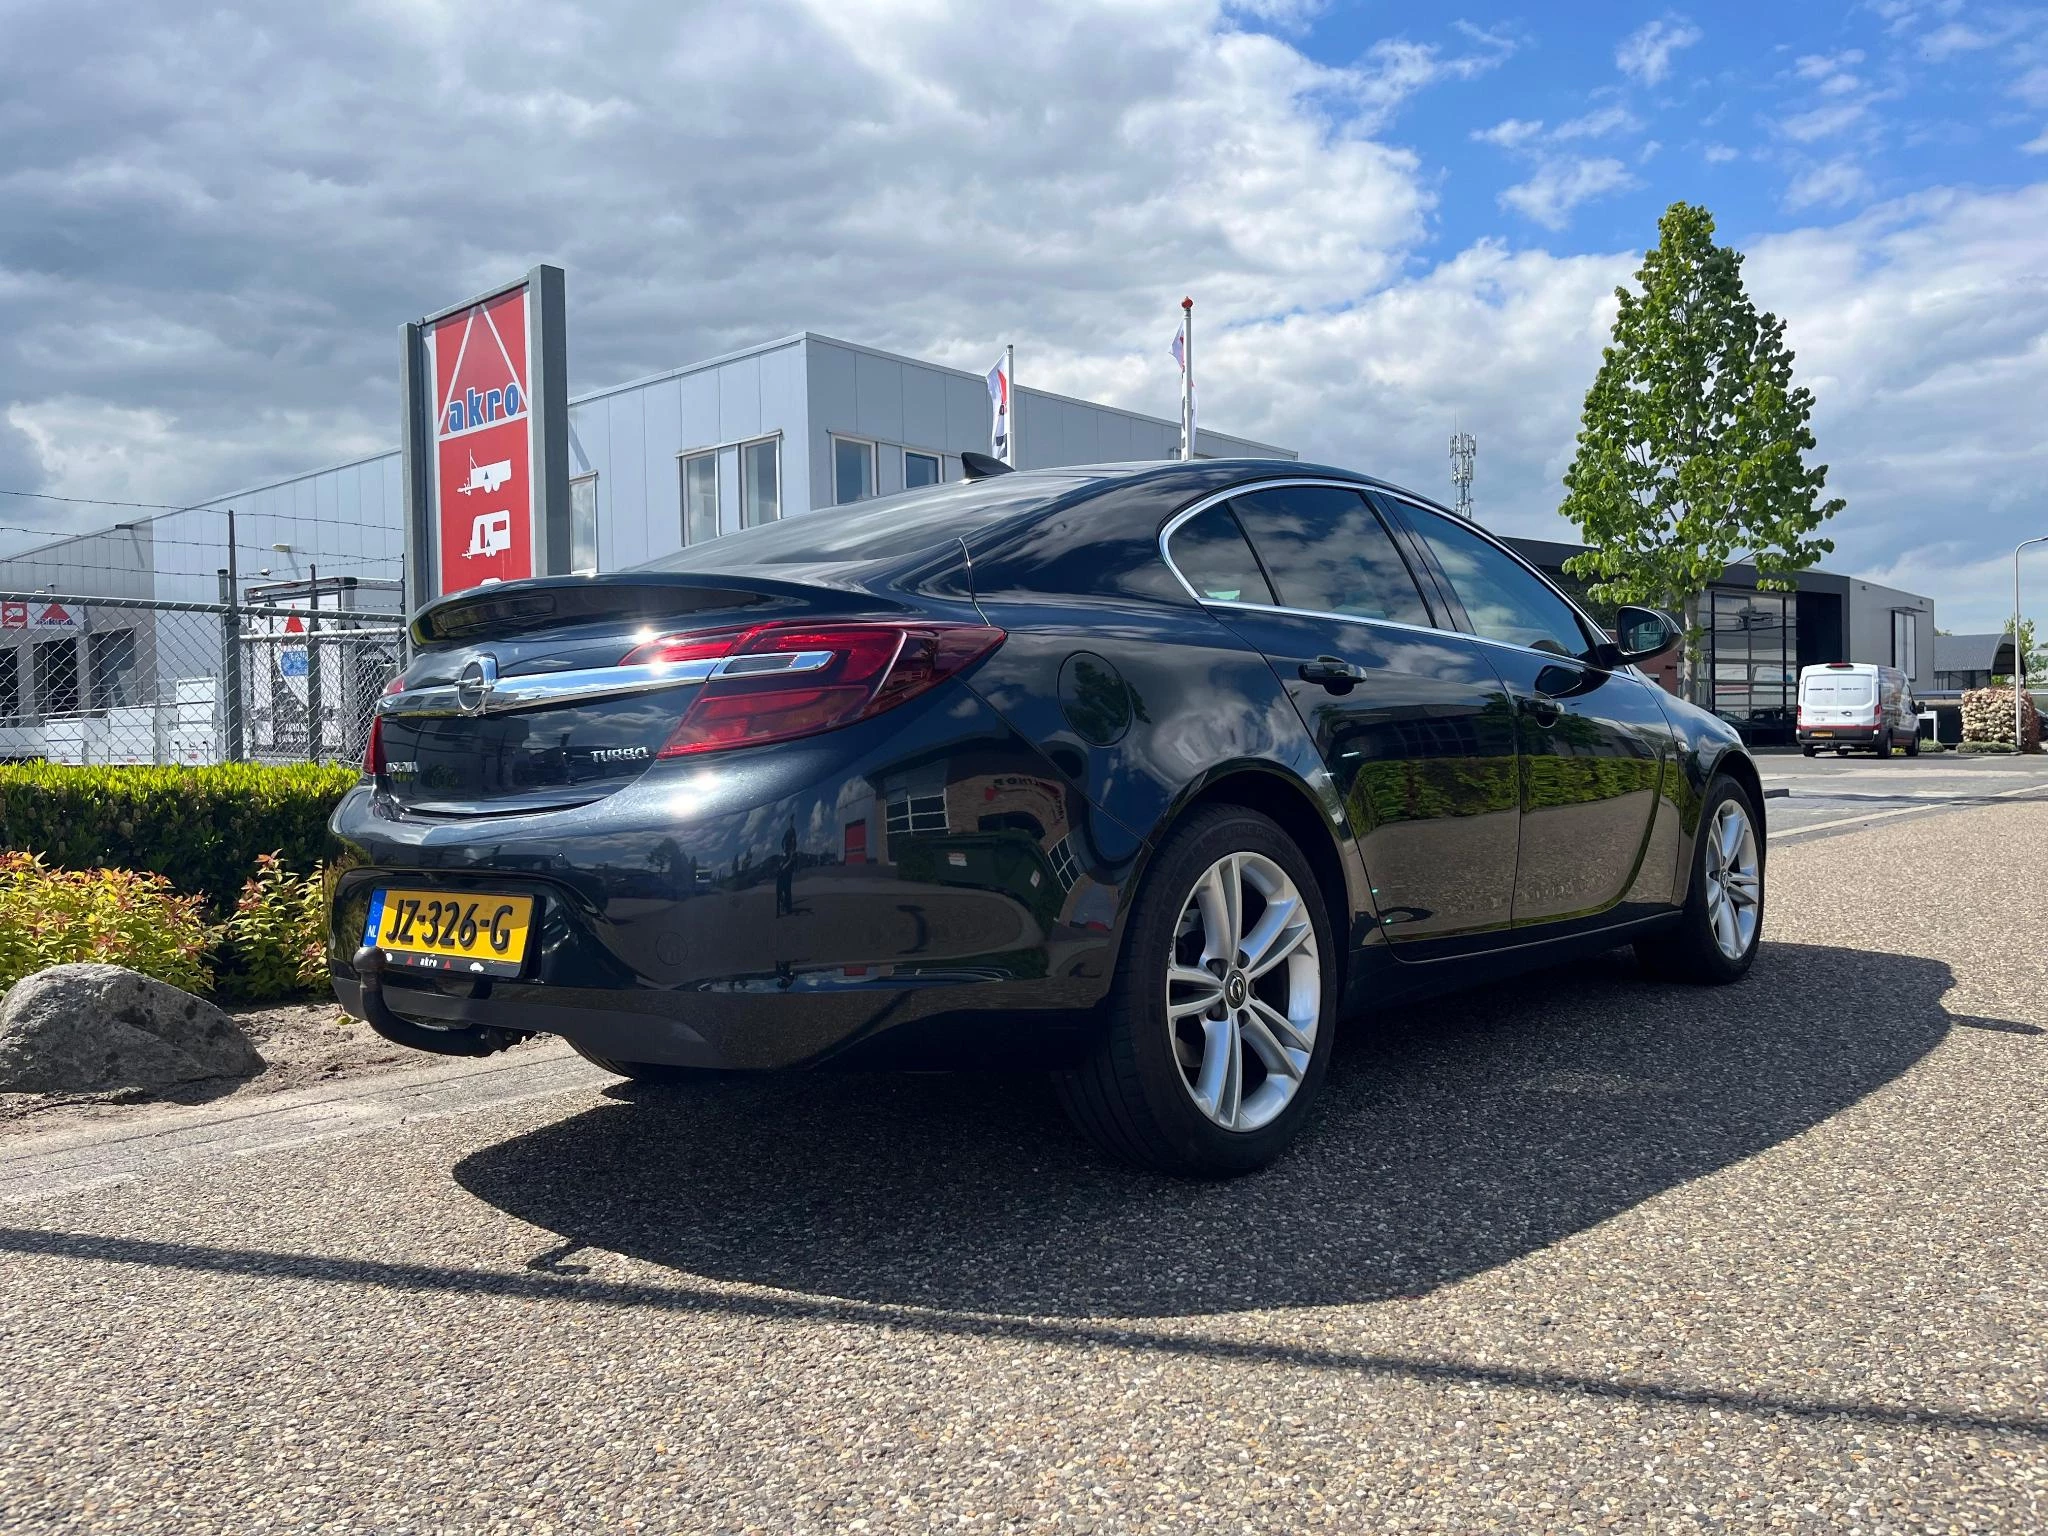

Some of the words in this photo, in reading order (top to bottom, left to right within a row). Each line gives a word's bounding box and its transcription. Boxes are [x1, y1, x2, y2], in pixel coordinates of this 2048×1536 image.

[448, 382, 520, 432] akro
[590, 746, 650, 762] TURBO
[367, 924, 377, 938] NL
[386, 899, 513, 951] JZ-326-G
